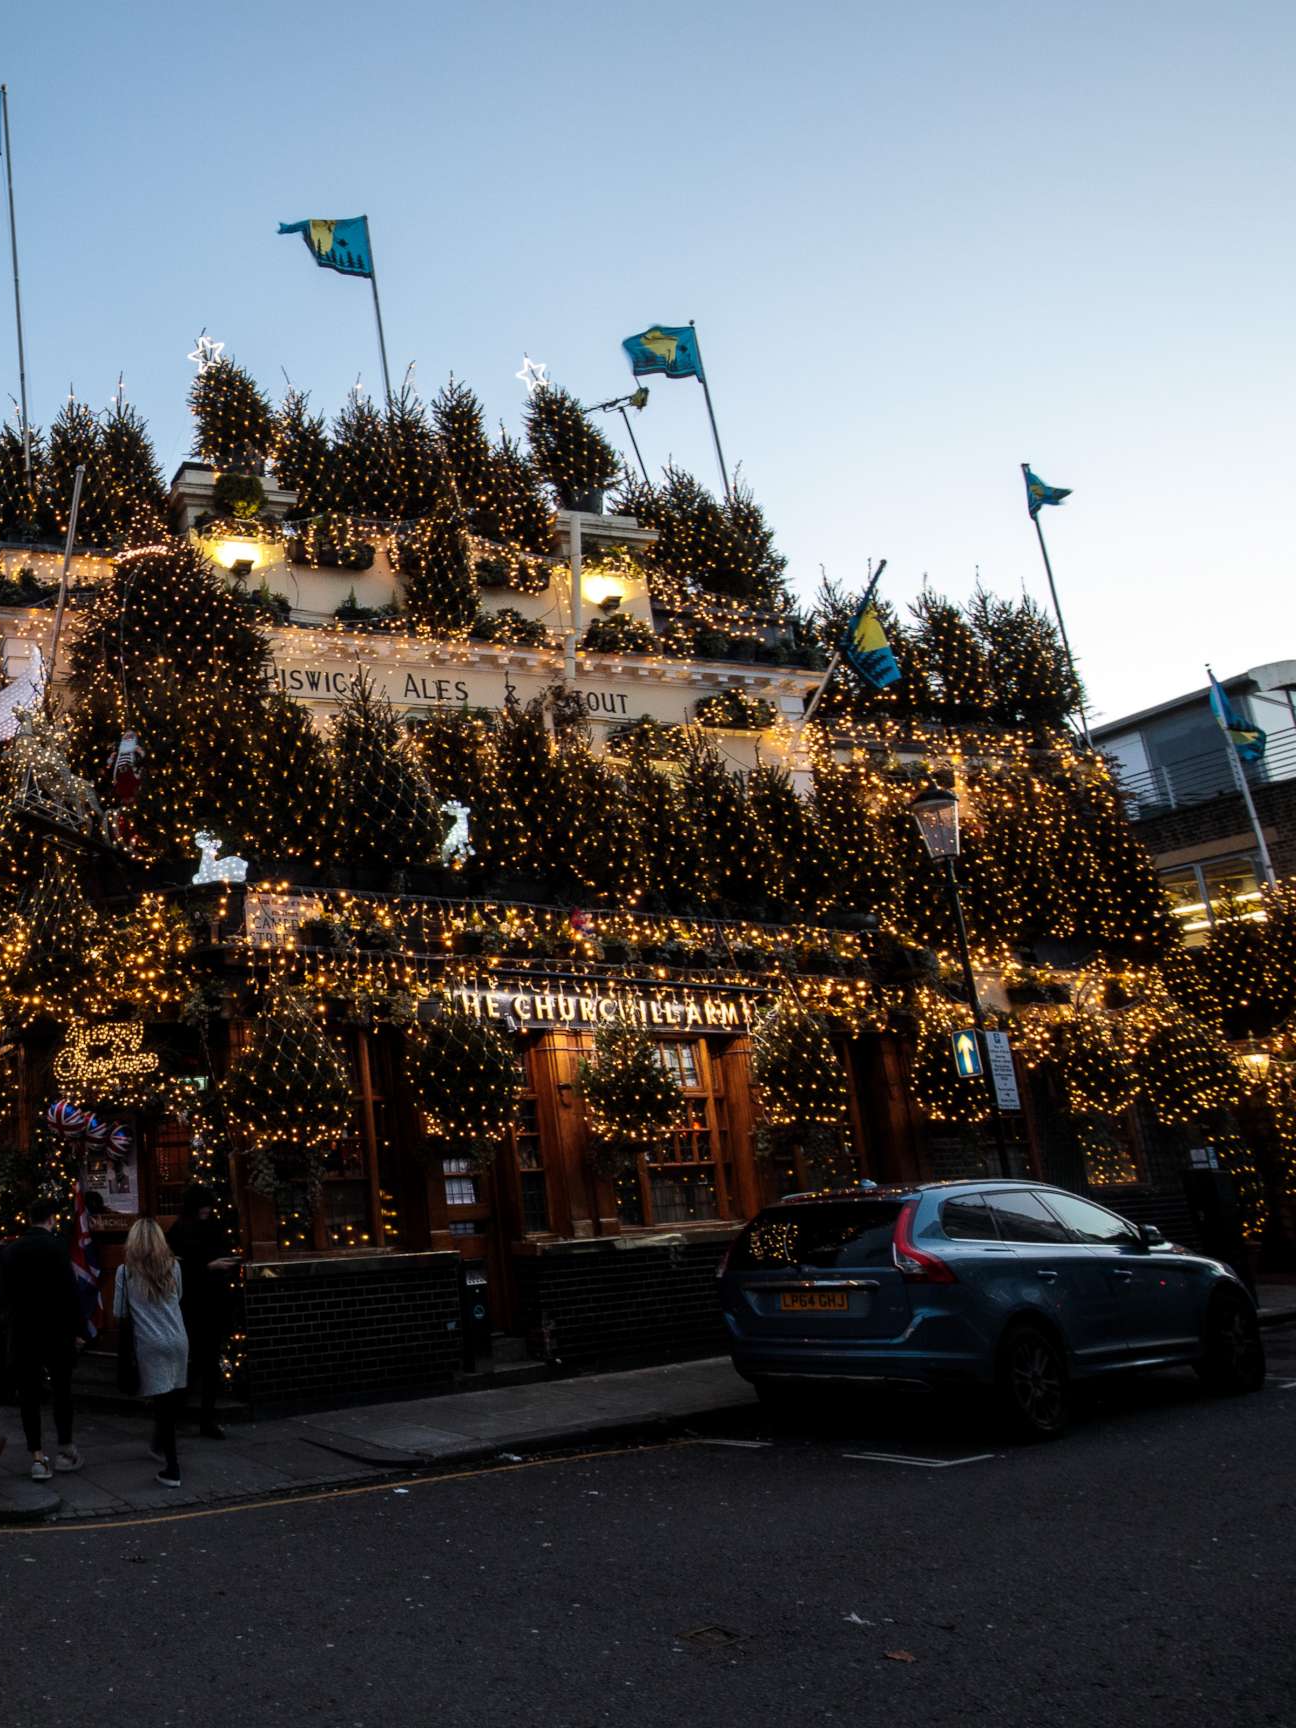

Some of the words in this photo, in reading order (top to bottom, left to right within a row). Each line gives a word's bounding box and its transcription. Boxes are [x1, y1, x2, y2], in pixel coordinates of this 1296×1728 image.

[404, 673, 469, 701] ALES
[568, 689, 629, 714] TOUT
[783, 1294, 815, 1307] LP64
